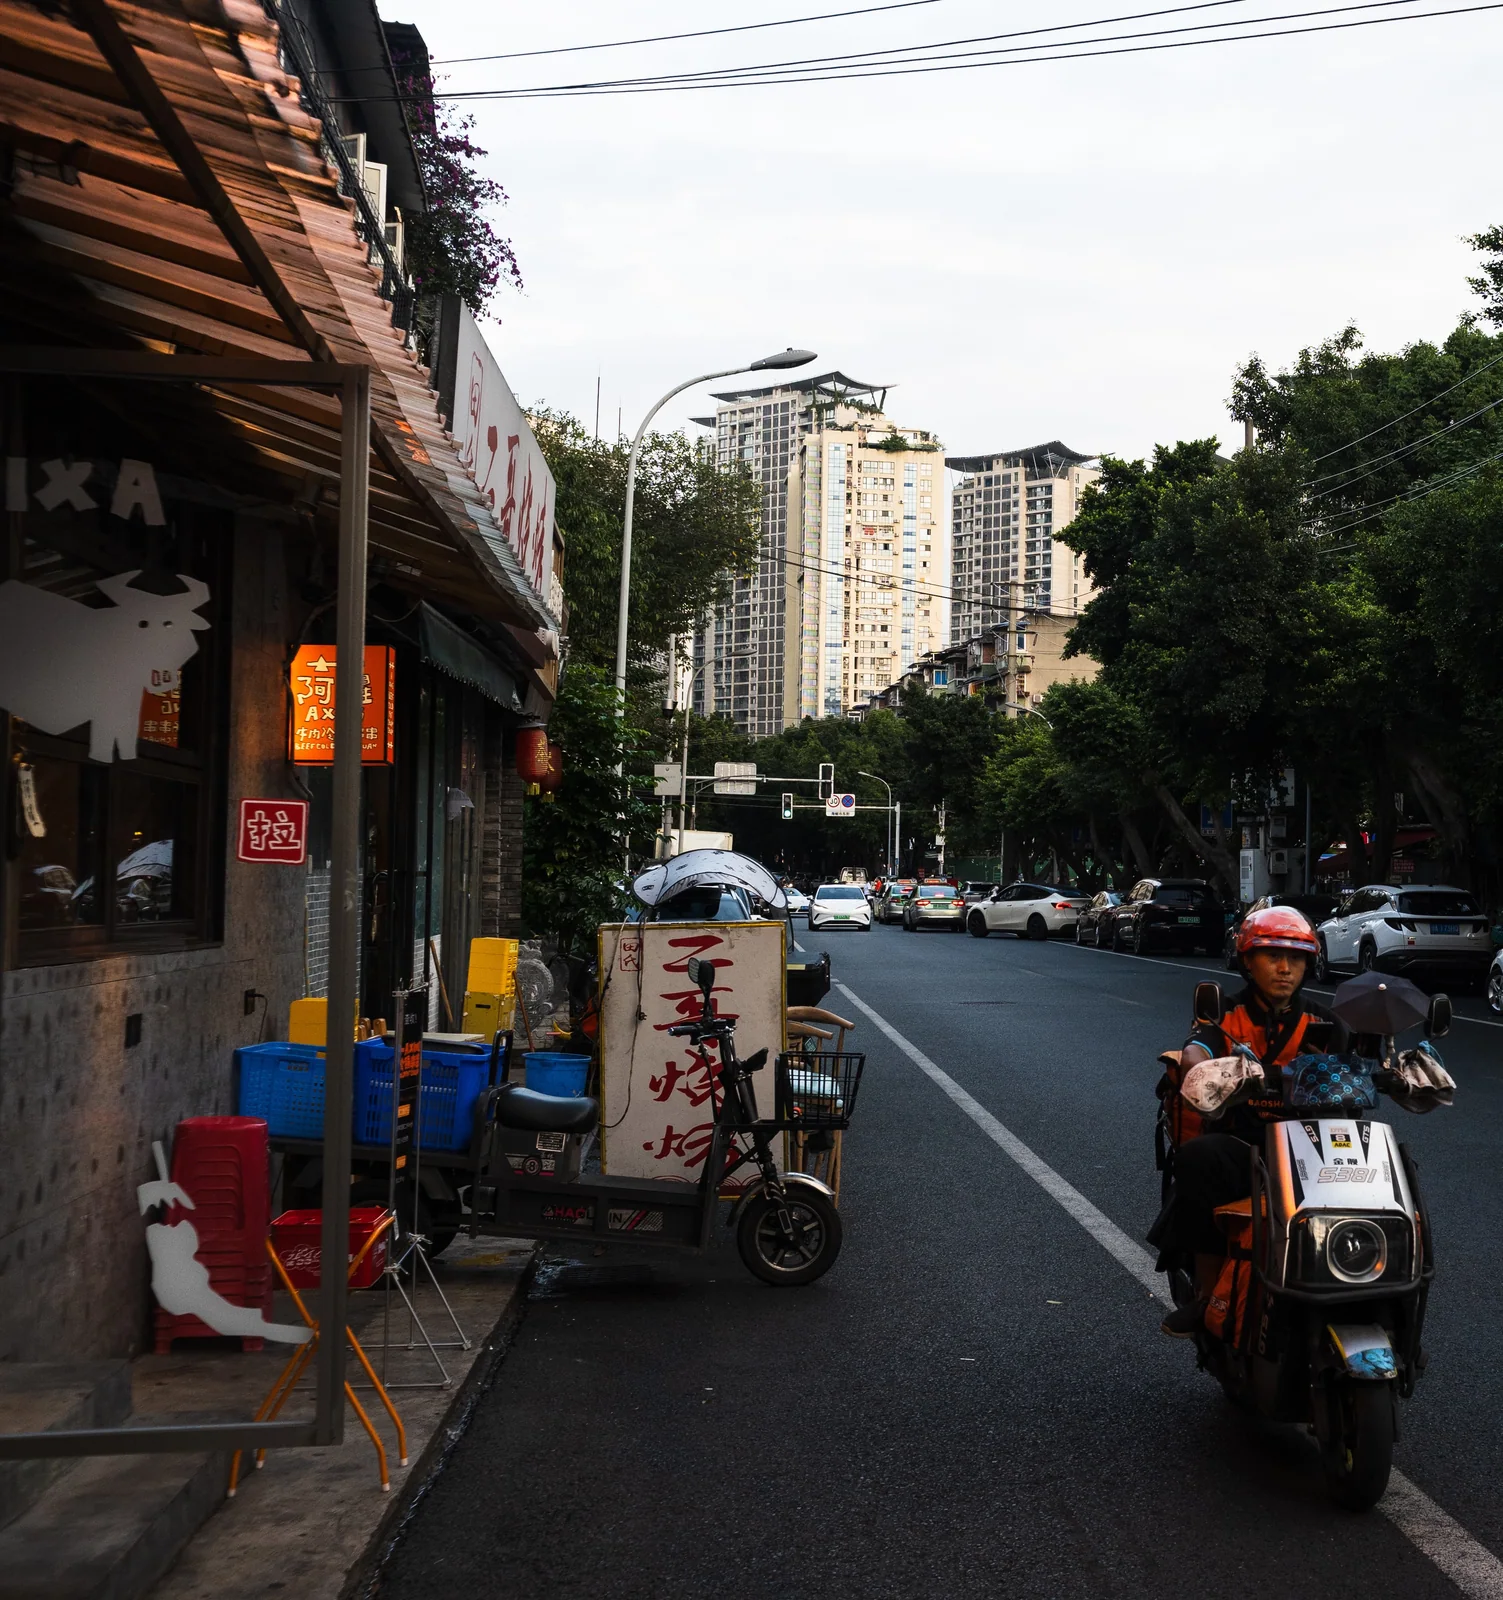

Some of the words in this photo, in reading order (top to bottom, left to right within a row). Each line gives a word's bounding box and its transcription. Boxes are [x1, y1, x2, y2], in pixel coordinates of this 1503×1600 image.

[246, 810, 301, 851] 拉
[1248, 1098, 1284, 1108] BAOSH
[1304, 1124, 1319, 1143] GTS
[1361, 1124, 1371, 1144] GTS
